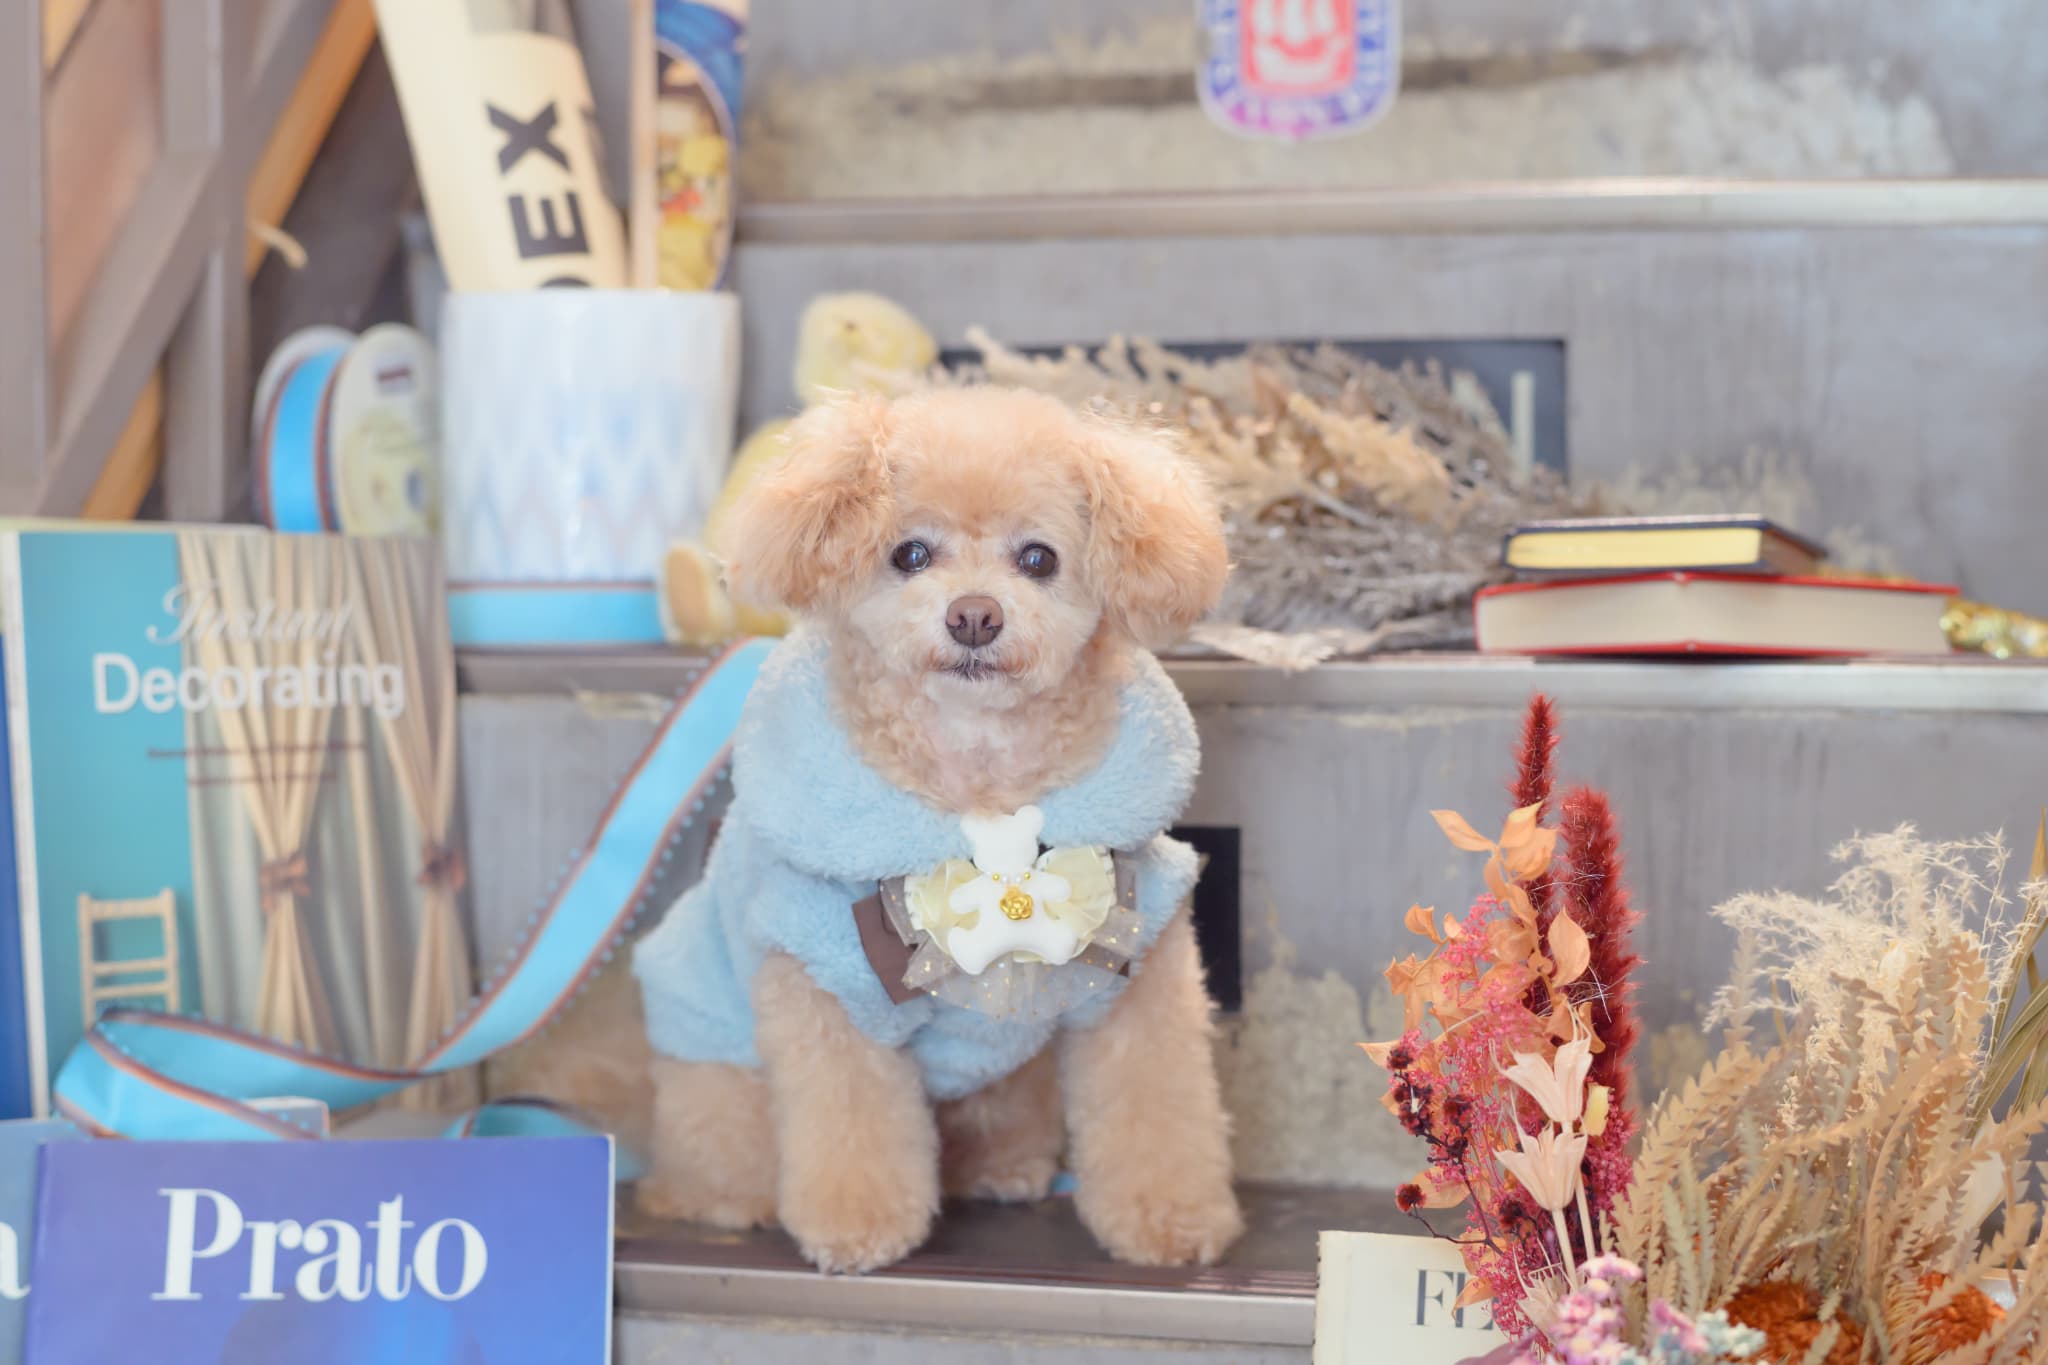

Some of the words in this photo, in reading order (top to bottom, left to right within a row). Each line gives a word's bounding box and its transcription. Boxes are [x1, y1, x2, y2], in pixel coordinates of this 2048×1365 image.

[485, 101, 594, 288] EX
[92, 653, 405, 719] Decorating
[151, 1188, 488, 1302] Prato
